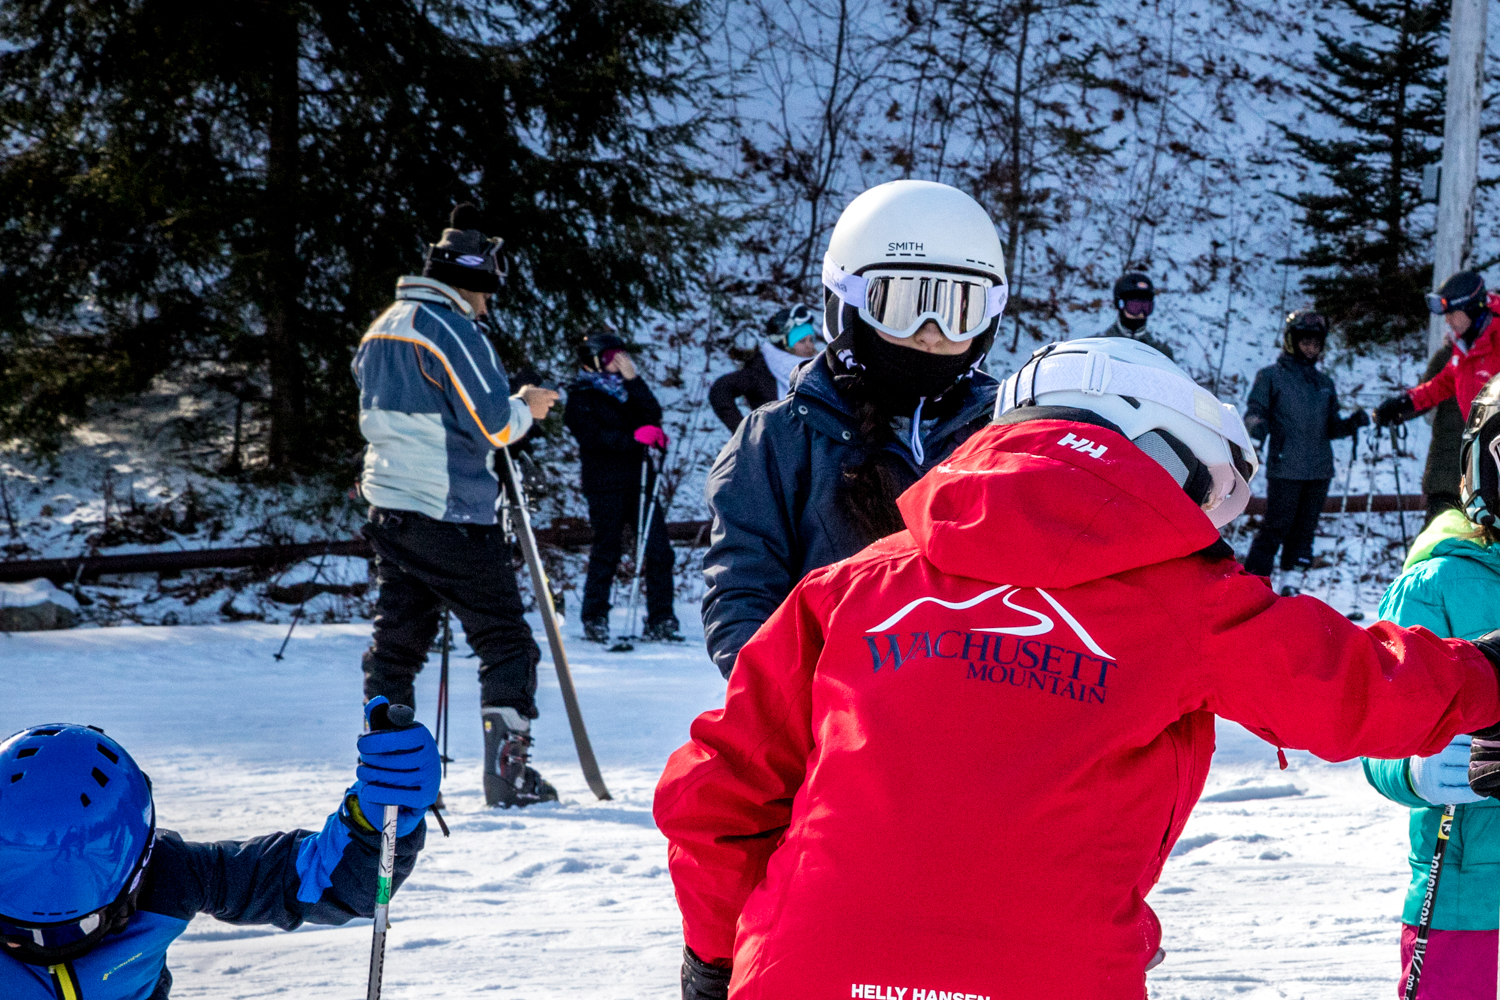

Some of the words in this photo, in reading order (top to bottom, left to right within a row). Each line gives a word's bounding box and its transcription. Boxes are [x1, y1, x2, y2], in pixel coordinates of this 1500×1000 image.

[888, 242, 924, 251] SMITH
[862, 630, 1118, 688] WACHUSETT
[966, 662, 1107, 704] MOUNTAIN
